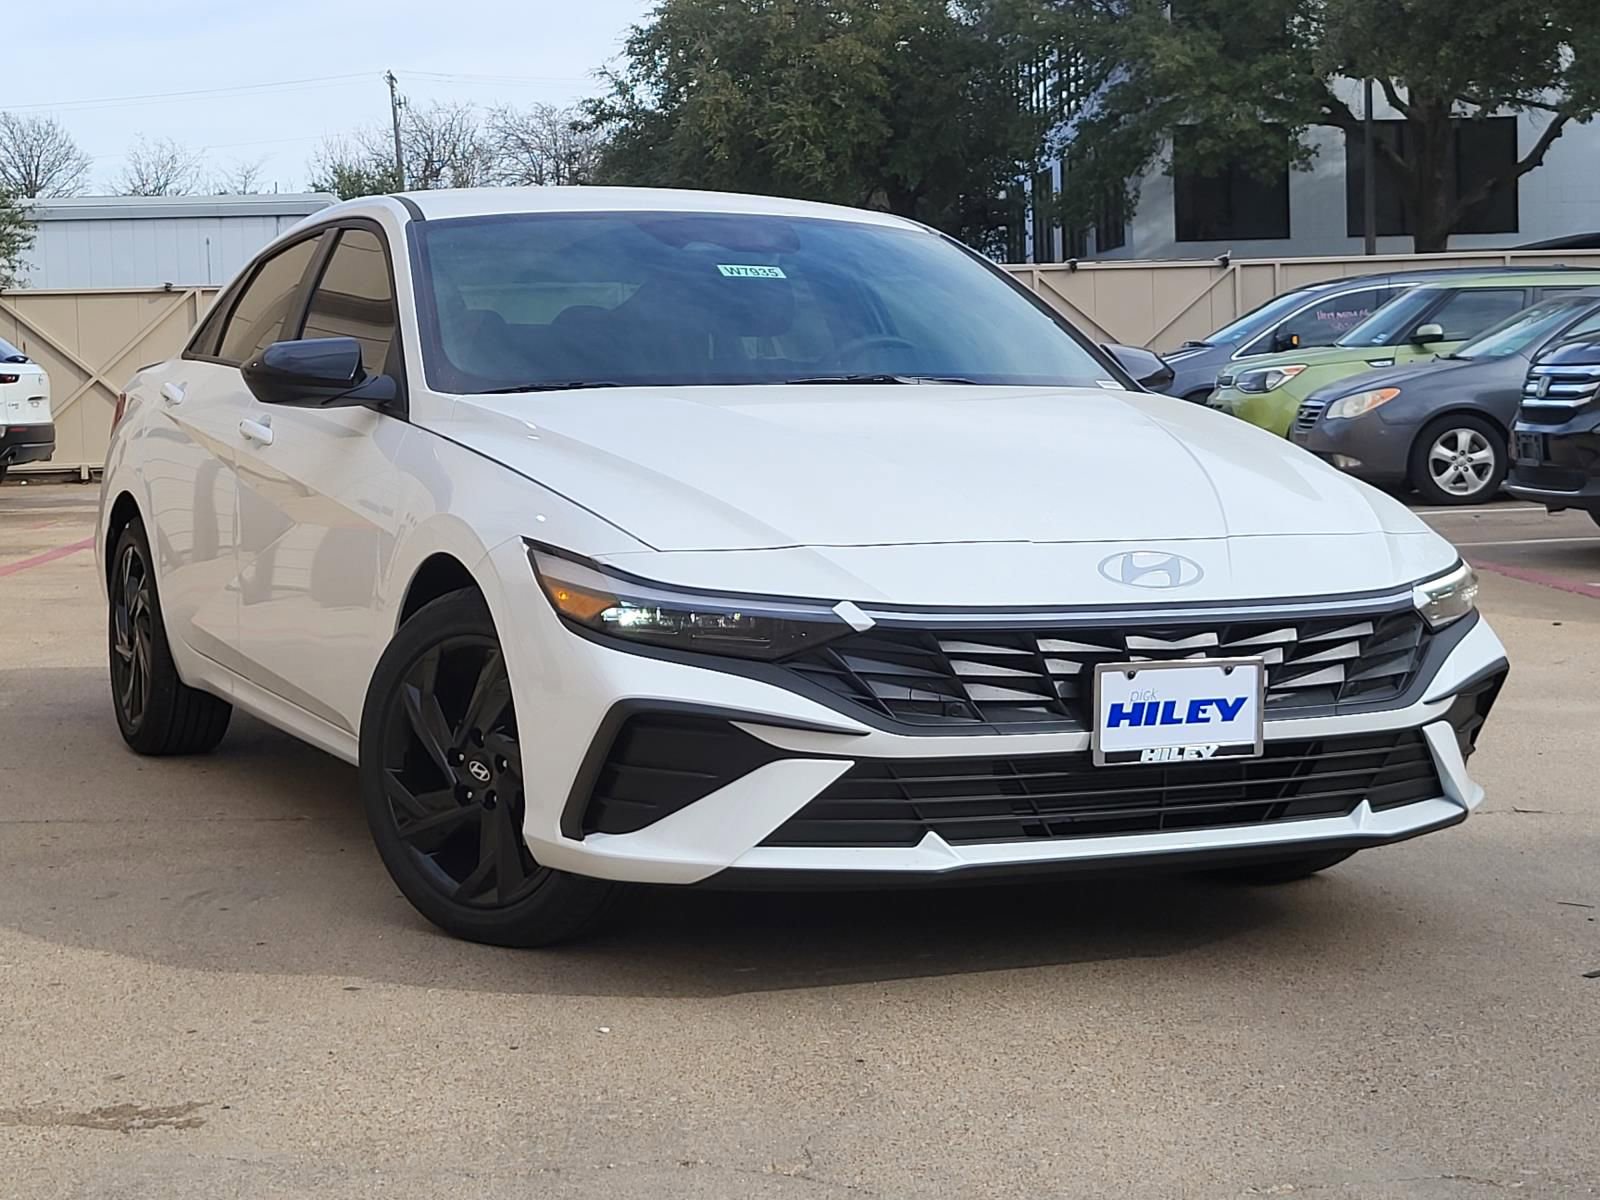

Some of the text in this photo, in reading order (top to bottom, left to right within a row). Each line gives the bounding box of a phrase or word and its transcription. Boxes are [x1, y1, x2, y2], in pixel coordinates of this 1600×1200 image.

[723, 266, 779, 277] W7935
[1130, 687, 1159, 702] pick
[1106, 696, 1248, 728] HILEY
[1140, 744, 1219, 763] HILEY
